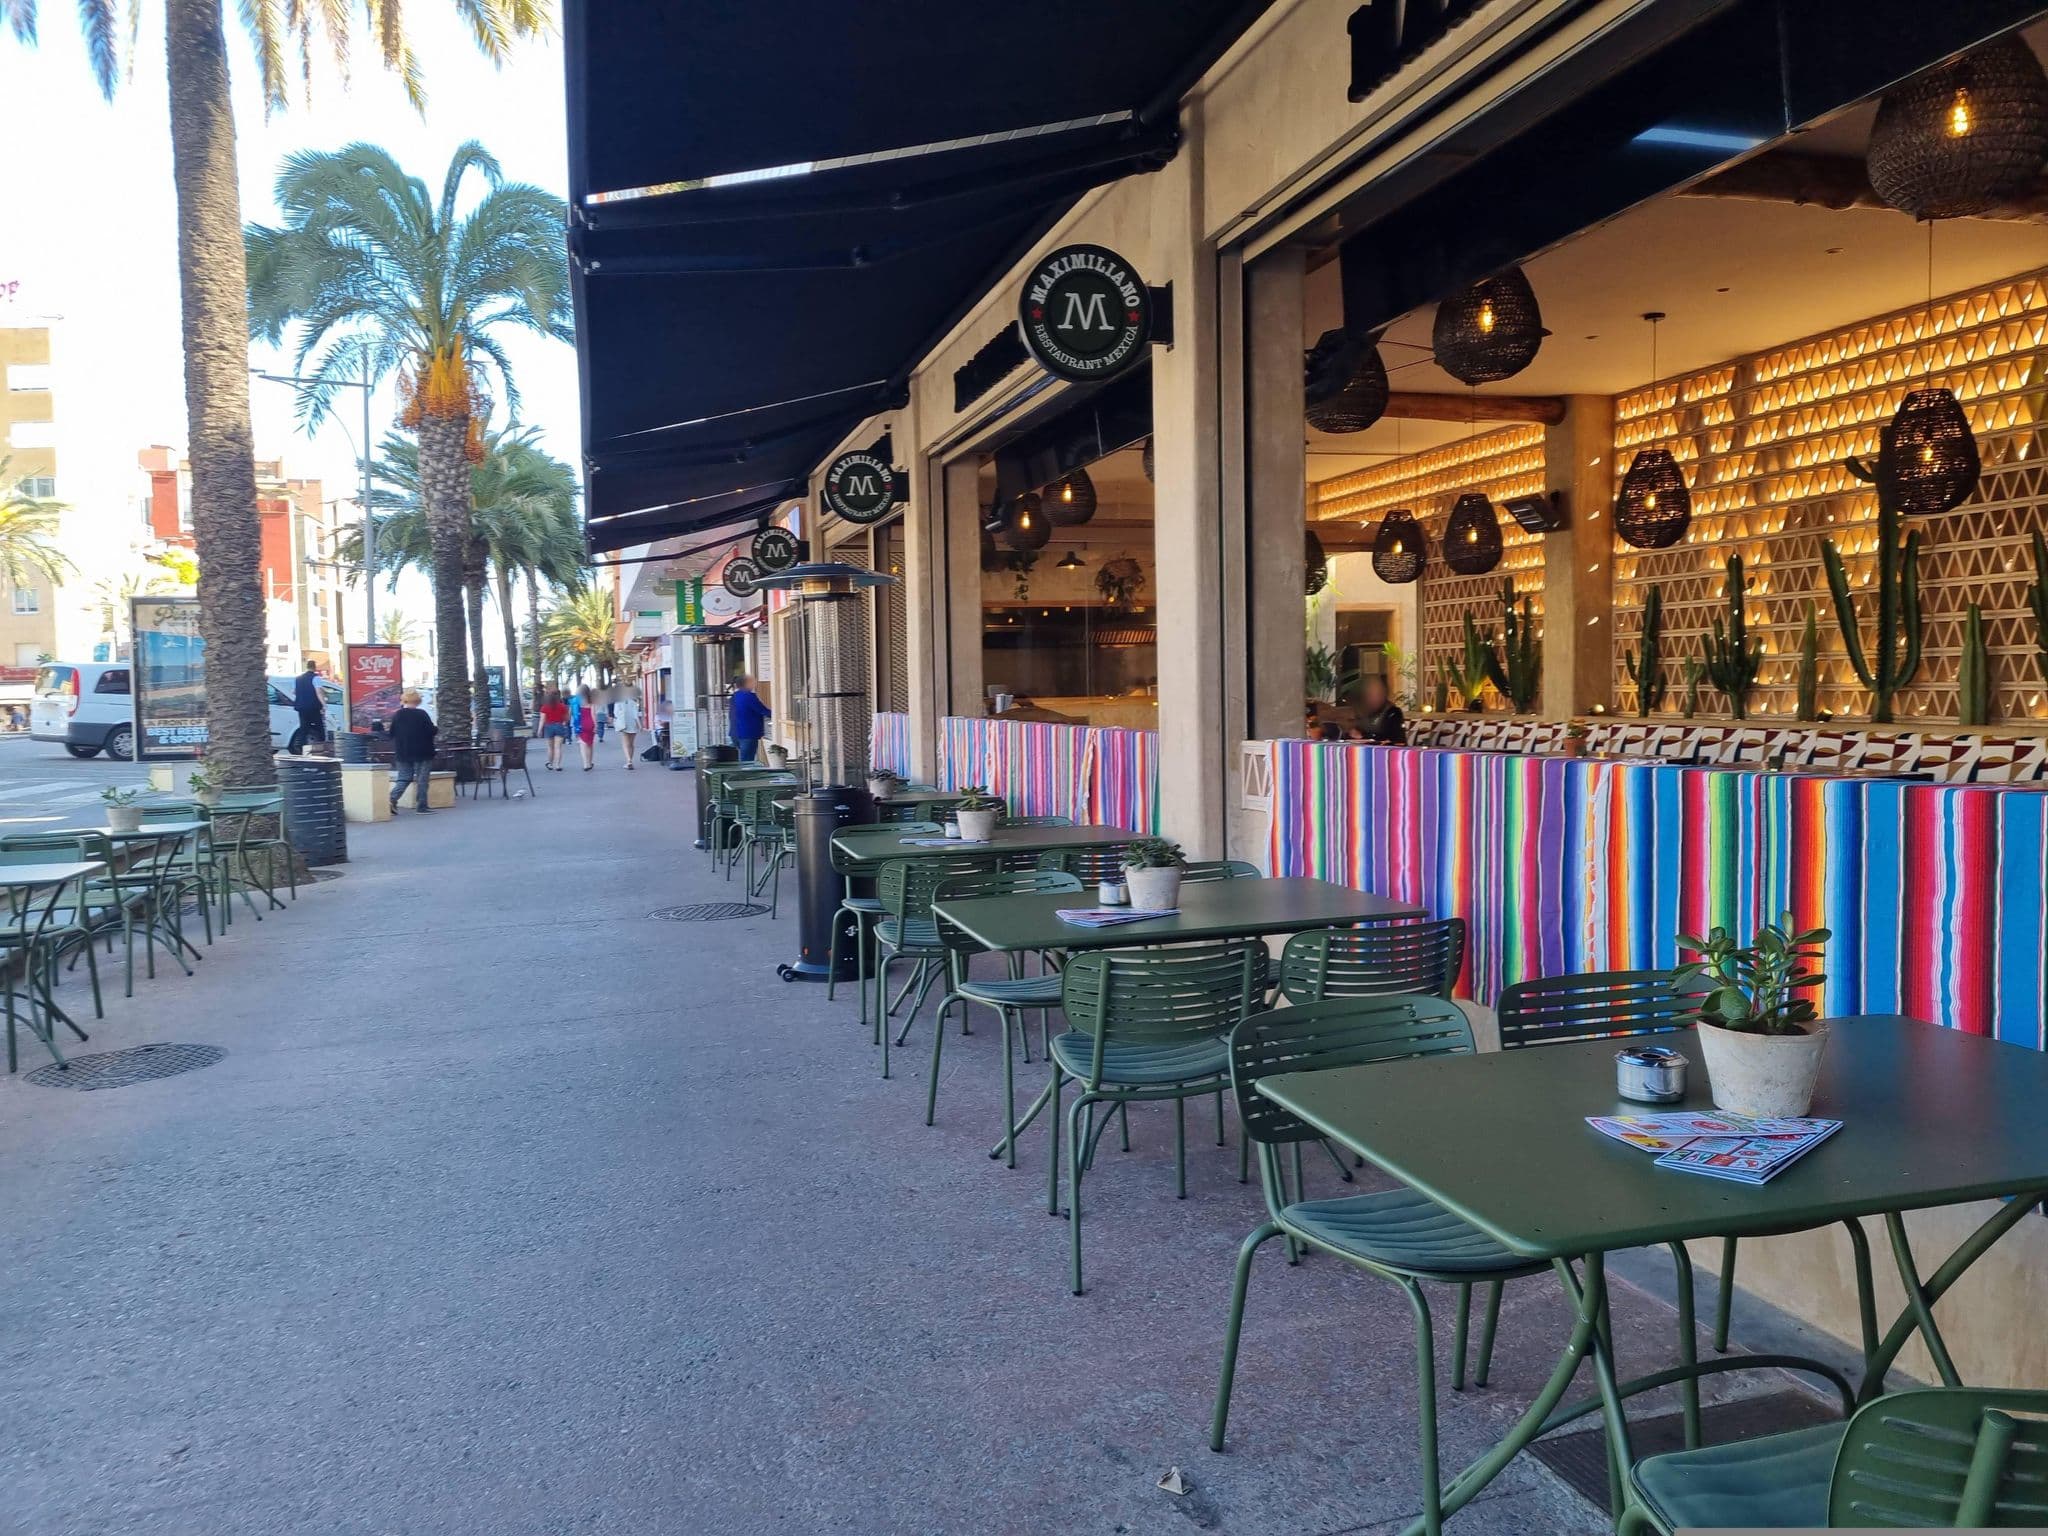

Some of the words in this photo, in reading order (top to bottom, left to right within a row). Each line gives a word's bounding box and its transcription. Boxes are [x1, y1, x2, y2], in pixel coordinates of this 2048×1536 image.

[1030, 253, 1140, 307] MAXIMILIANO
[1057, 292, 1115, 330] M
[1034, 324, 1103, 370] RESTAURANT
[830, 455, 892, 483] MAXIMILIANO
[845, 475, 879, 496] M
[765, 543, 788, 558] M
[733, 570, 751, 583] M
[684, 579, 696, 624] SUBWAY
[146, 727, 176, 737] BEST
